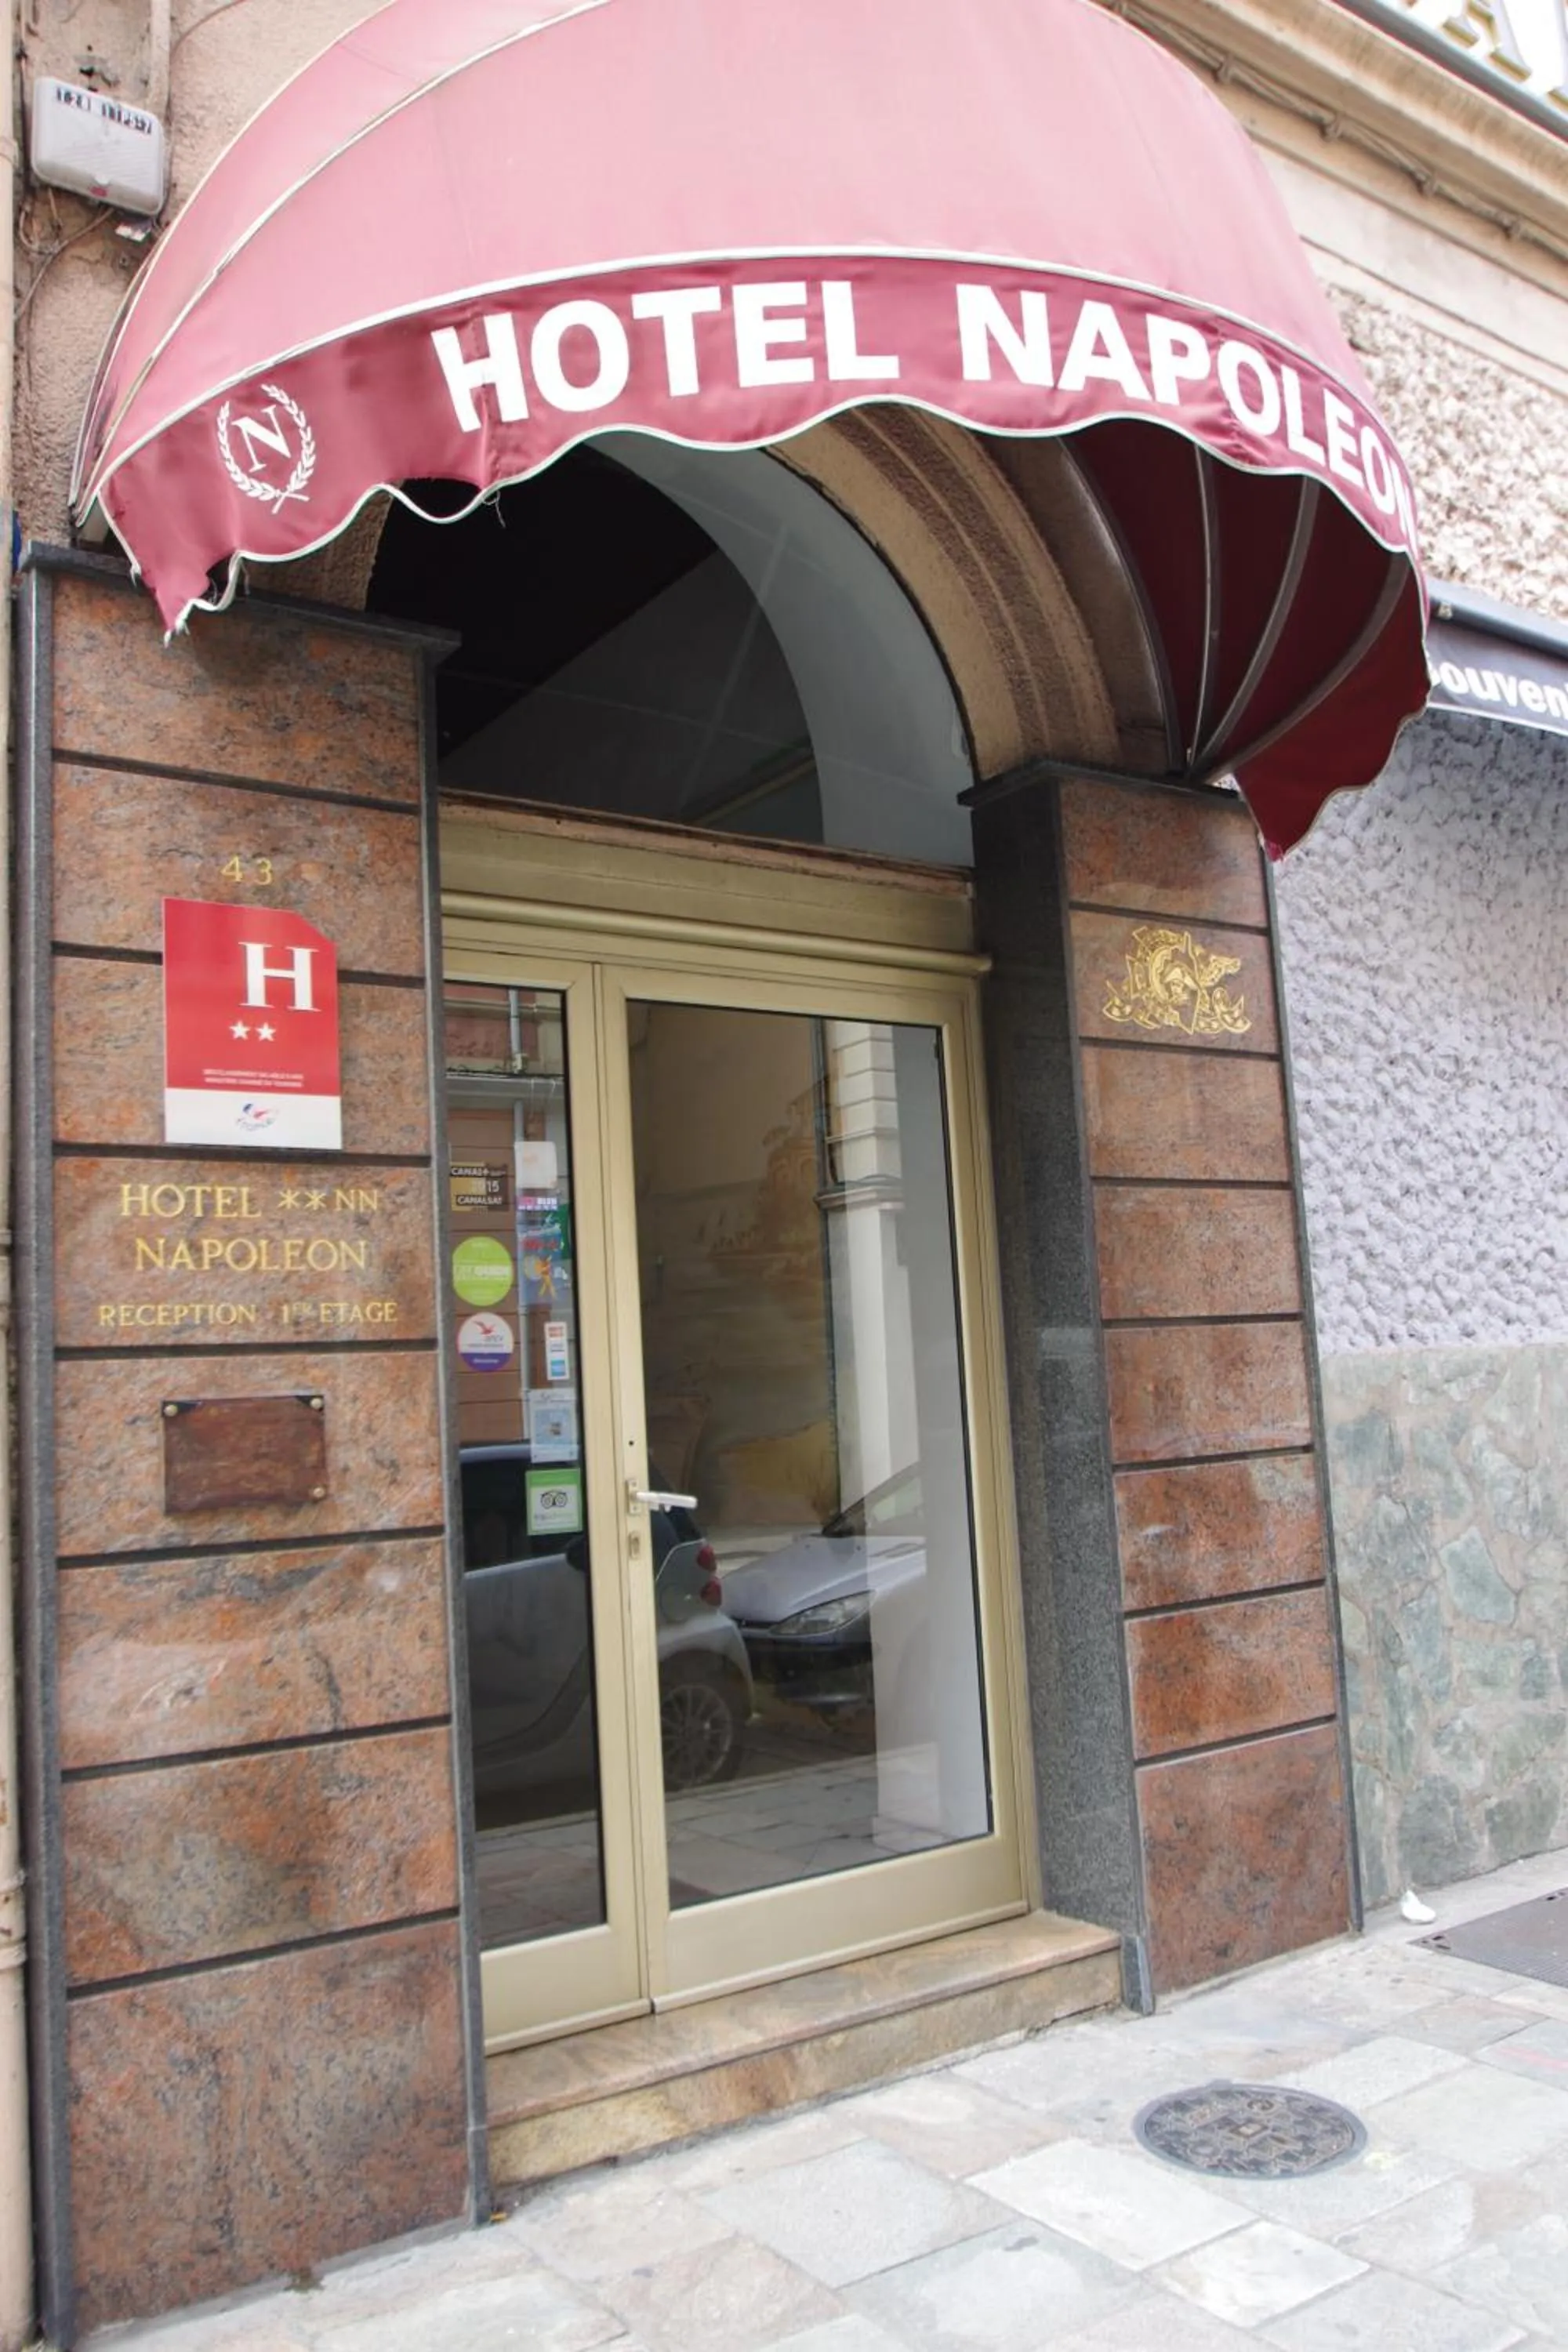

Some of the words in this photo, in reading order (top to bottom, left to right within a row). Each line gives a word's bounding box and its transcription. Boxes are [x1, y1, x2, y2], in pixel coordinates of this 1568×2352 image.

[235, 405, 292, 473] N
[430, 280, 900, 433] HOTEL
[955, 283, 1419, 562] NAPOLEON
[1428, 657, 1568, 721] ouven
[220, 855, 273, 886] 43
[238, 941, 321, 1012] H
[121, 1182, 263, 1218] HOTEL
[334, 1189, 379, 1212] NN
[134, 1236, 370, 1272] NAPOLEON
[99, 1303, 259, 1327] RECEPTION
[319, 1301, 400, 1324] ETAGE
